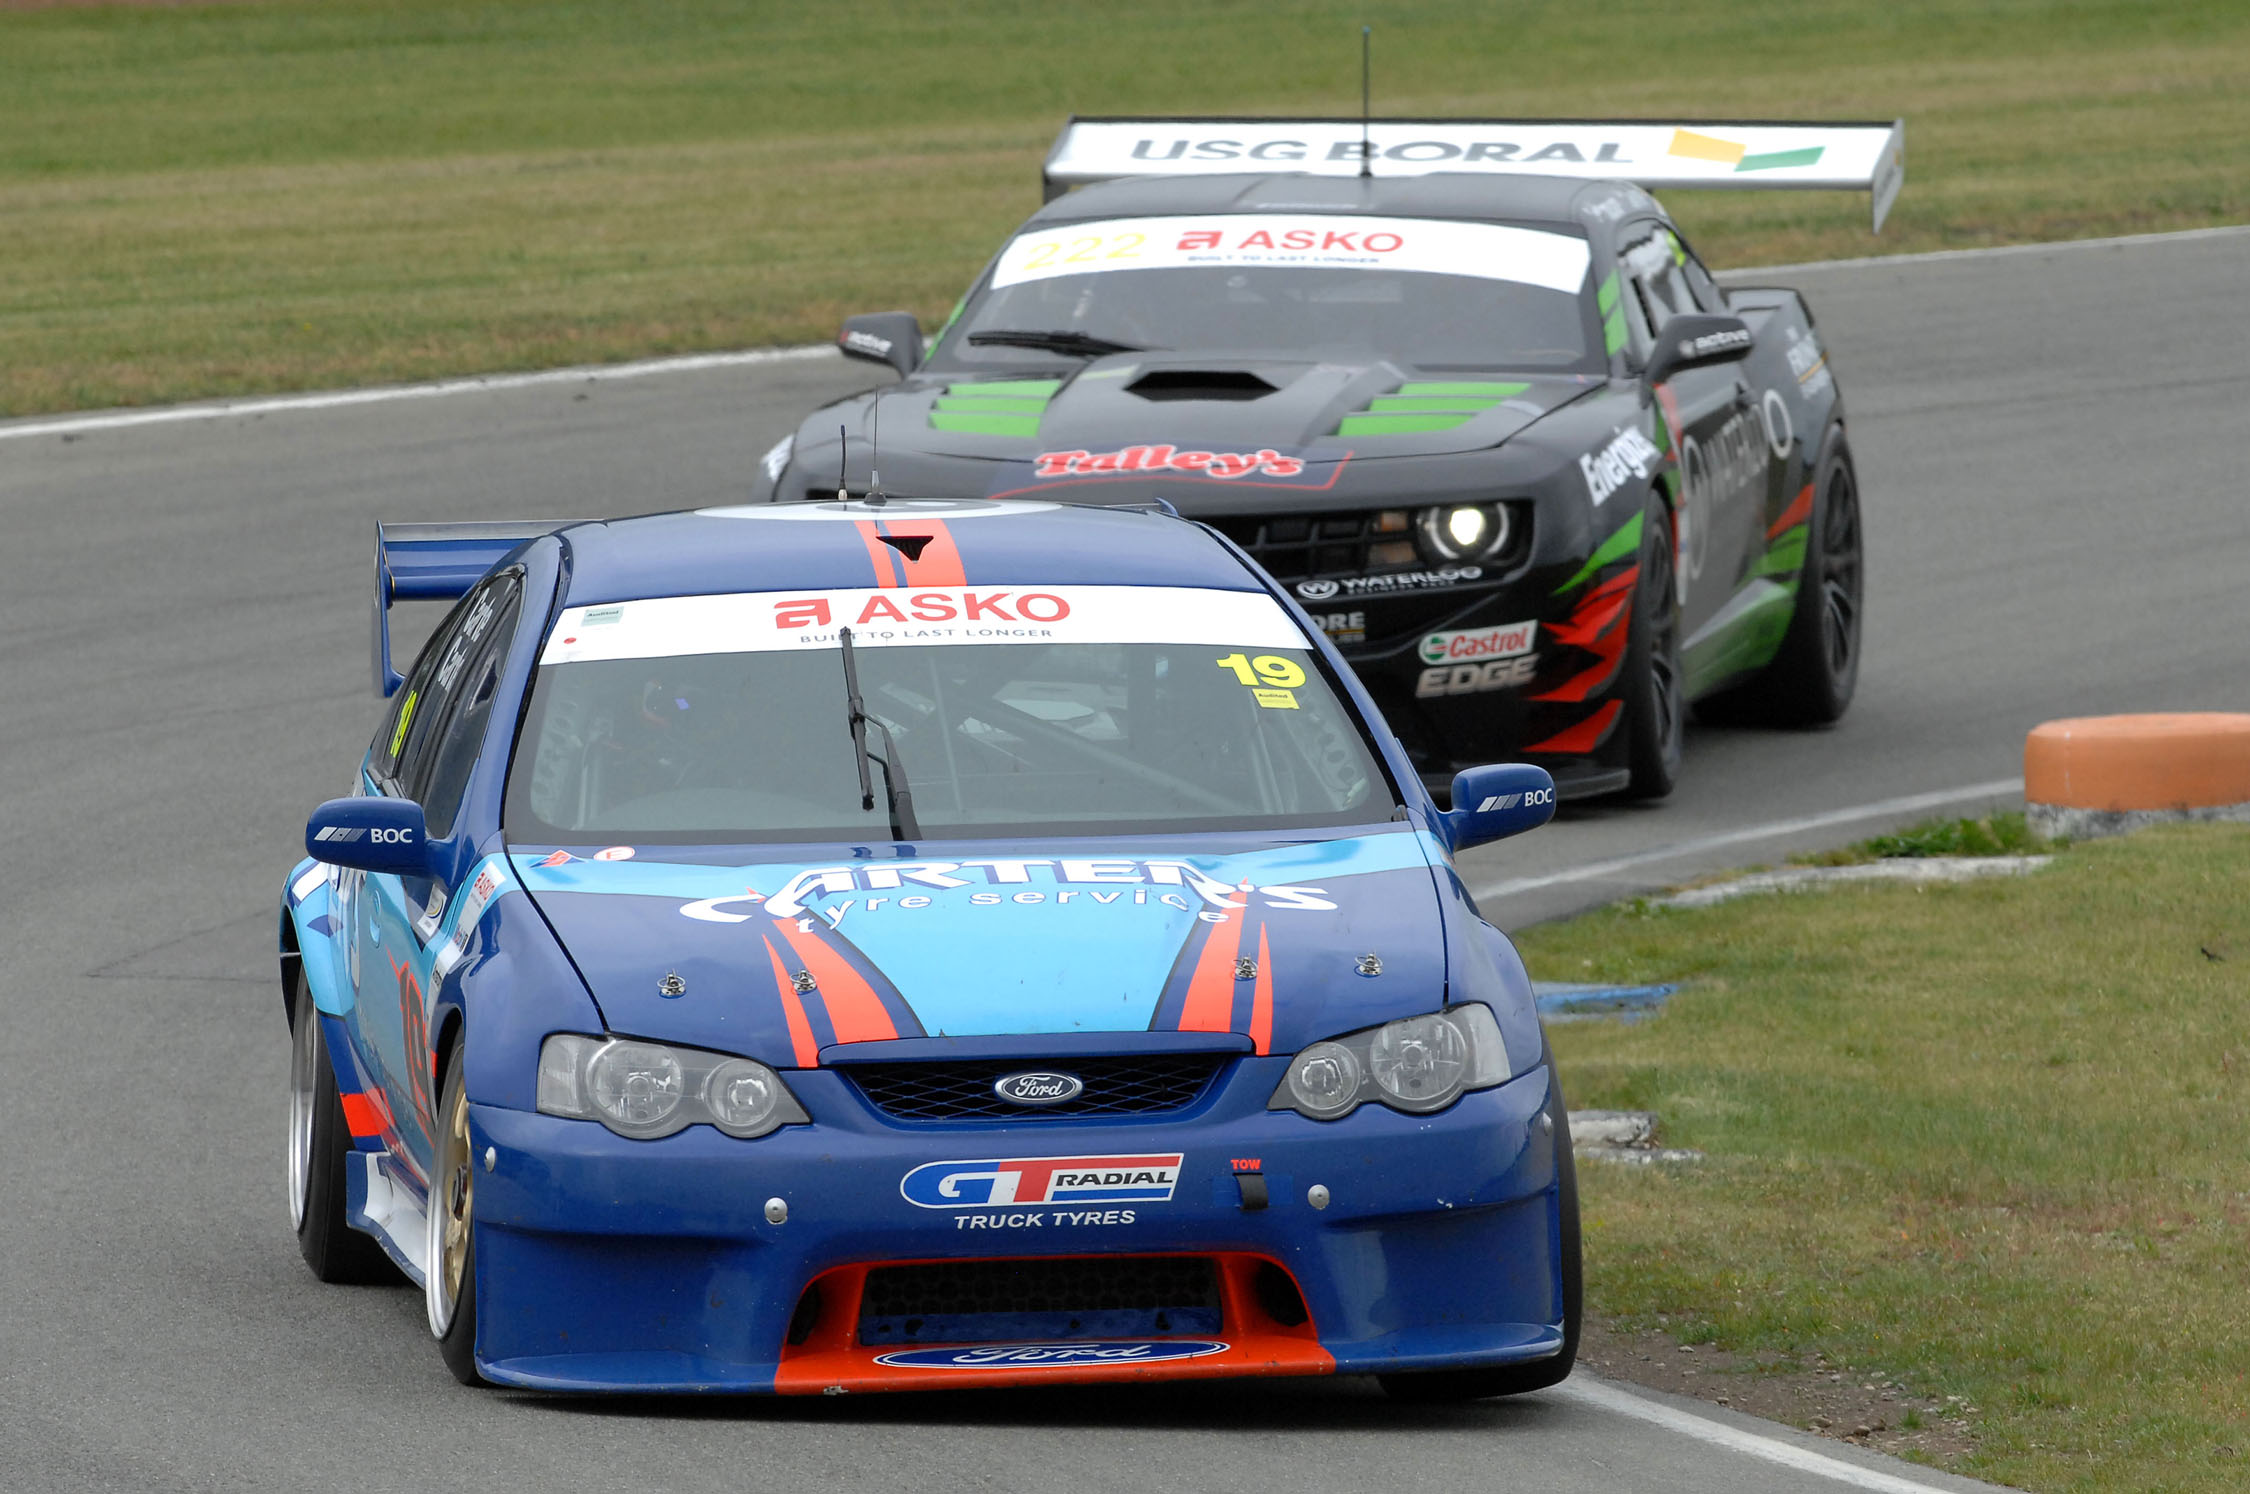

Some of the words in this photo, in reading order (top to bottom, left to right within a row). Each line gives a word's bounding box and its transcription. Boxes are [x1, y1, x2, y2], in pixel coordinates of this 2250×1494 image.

[1130, 139, 1307, 161] USG
[1325, 140, 1634, 163] BORAL
[1023, 232, 1147, 271] 222
[1237, 229, 1404, 253] ASKO
[1034, 445, 1305, 478] Talley's
[1341, 566, 1482, 589] WATERLOO
[856, 593, 1071, 624] ASKO
[869, 630, 895, 640] TO
[903, 629, 956, 638] LAST
[965, 628, 1053, 638] LONGER
[1449, 626, 1528, 658] Castrol
[1216, 653, 1306, 688] 19
[1415, 653, 1539, 698] EDGE
[1524, 787, 1553, 807] BOC
[370, 828, 413, 844] BOC
[680, 859, 1339, 919] CARTER'S
[796, 896, 933, 934] tyre
[968, 889, 1230, 923] service
[1014, 1076, 1062, 1096] Ford
[1231, 1158, 1261, 1170] TOW
[1055, 1172, 1174, 1187] RADIAL
[954, 1213, 1044, 1230] TRUCK
[1052, 1210, 1136, 1226] TYRES
[951, 1344, 1152, 1363] Ford
